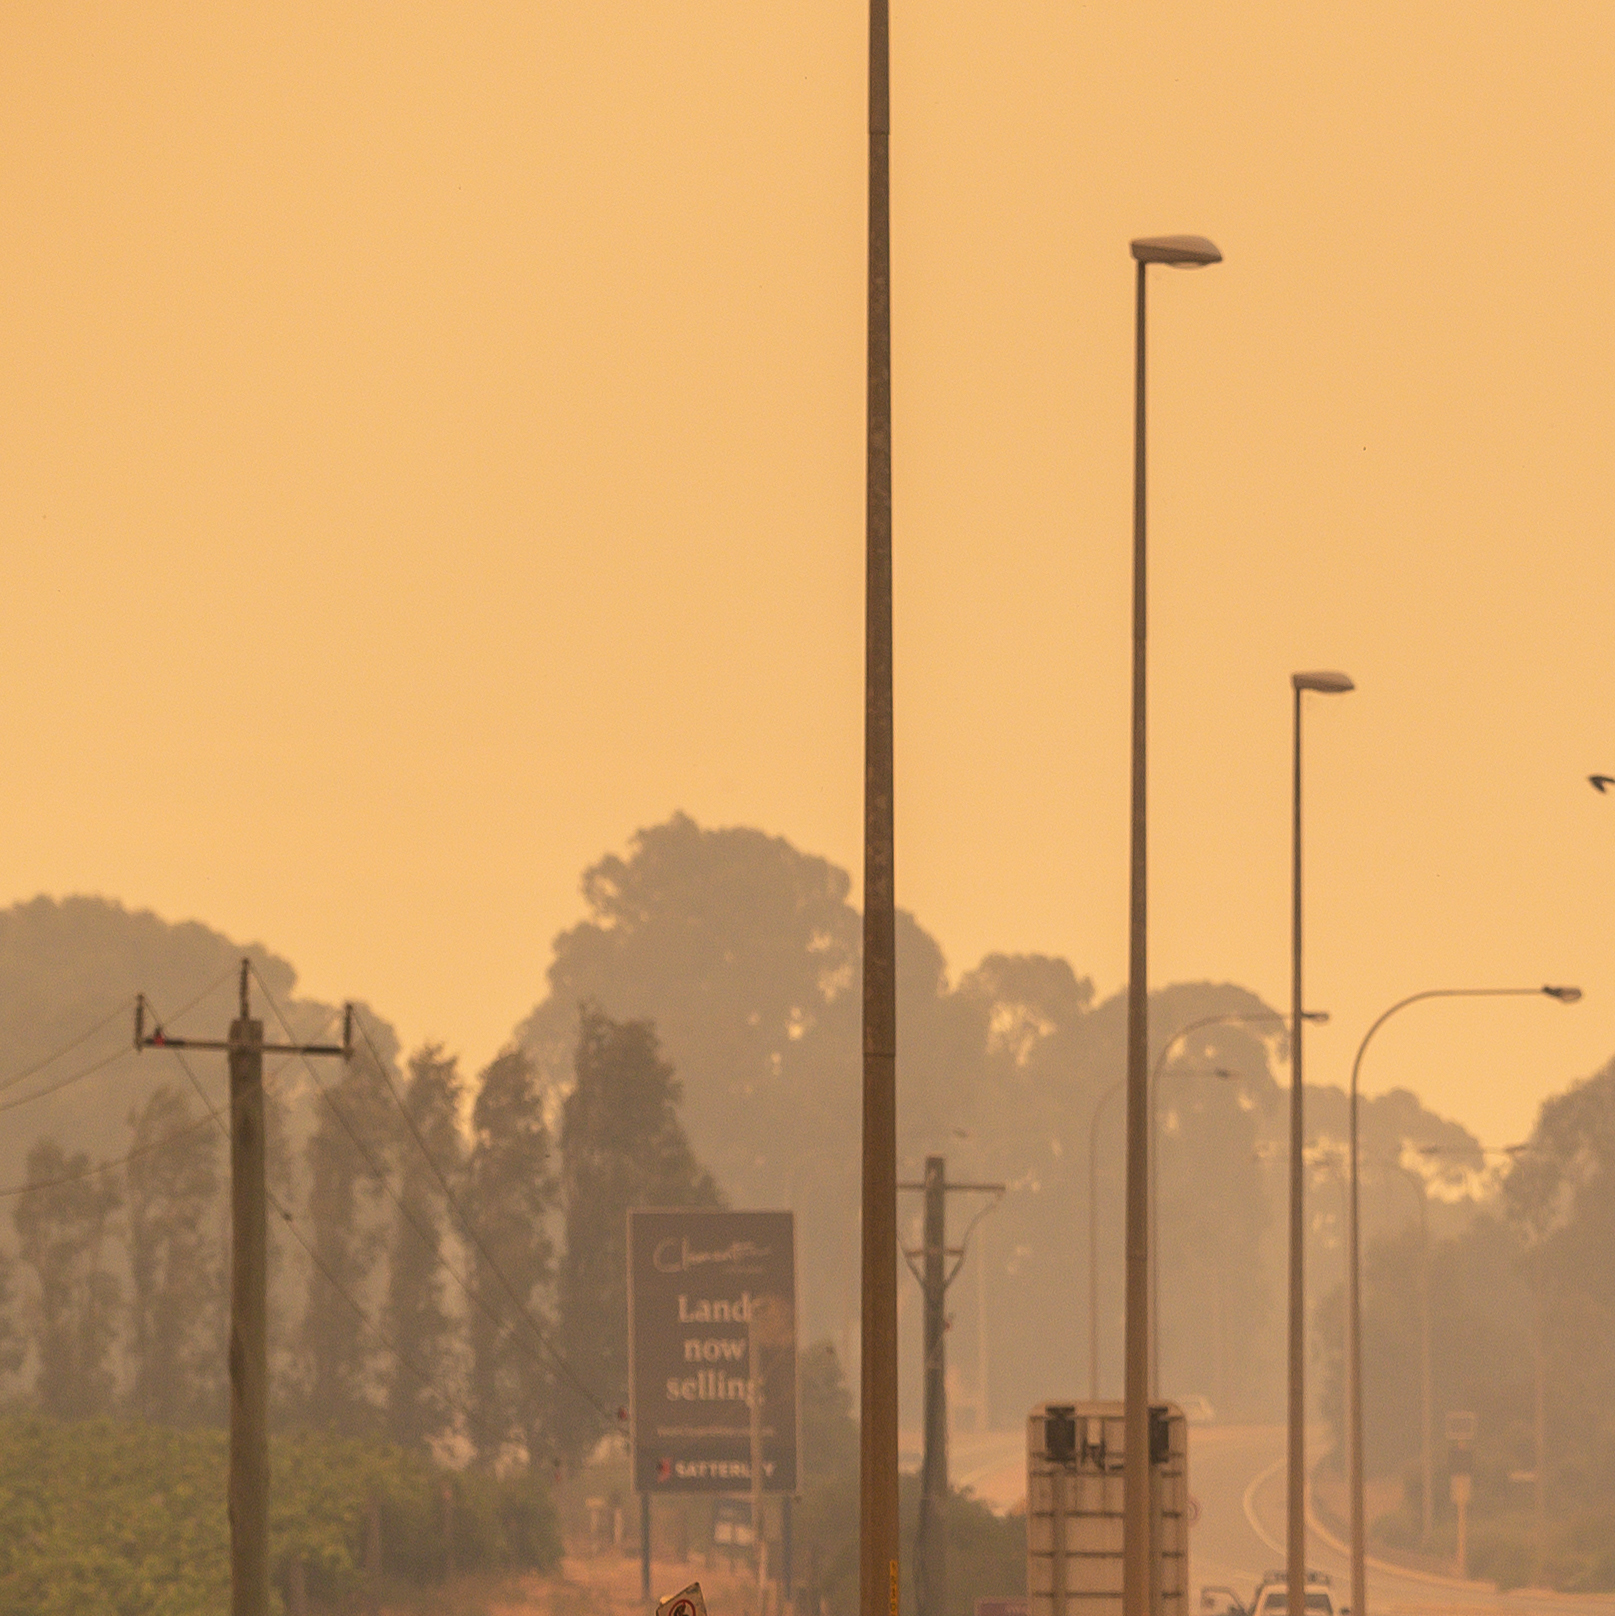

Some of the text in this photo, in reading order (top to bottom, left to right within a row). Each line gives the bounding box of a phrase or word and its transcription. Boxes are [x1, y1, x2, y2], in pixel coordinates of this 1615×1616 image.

[678, 1291, 753, 1323] Land
[684, 1337, 747, 1363] now
[666, 1370, 767, 1406] selling
[674, 1460, 776, 1479] SATTERLY
